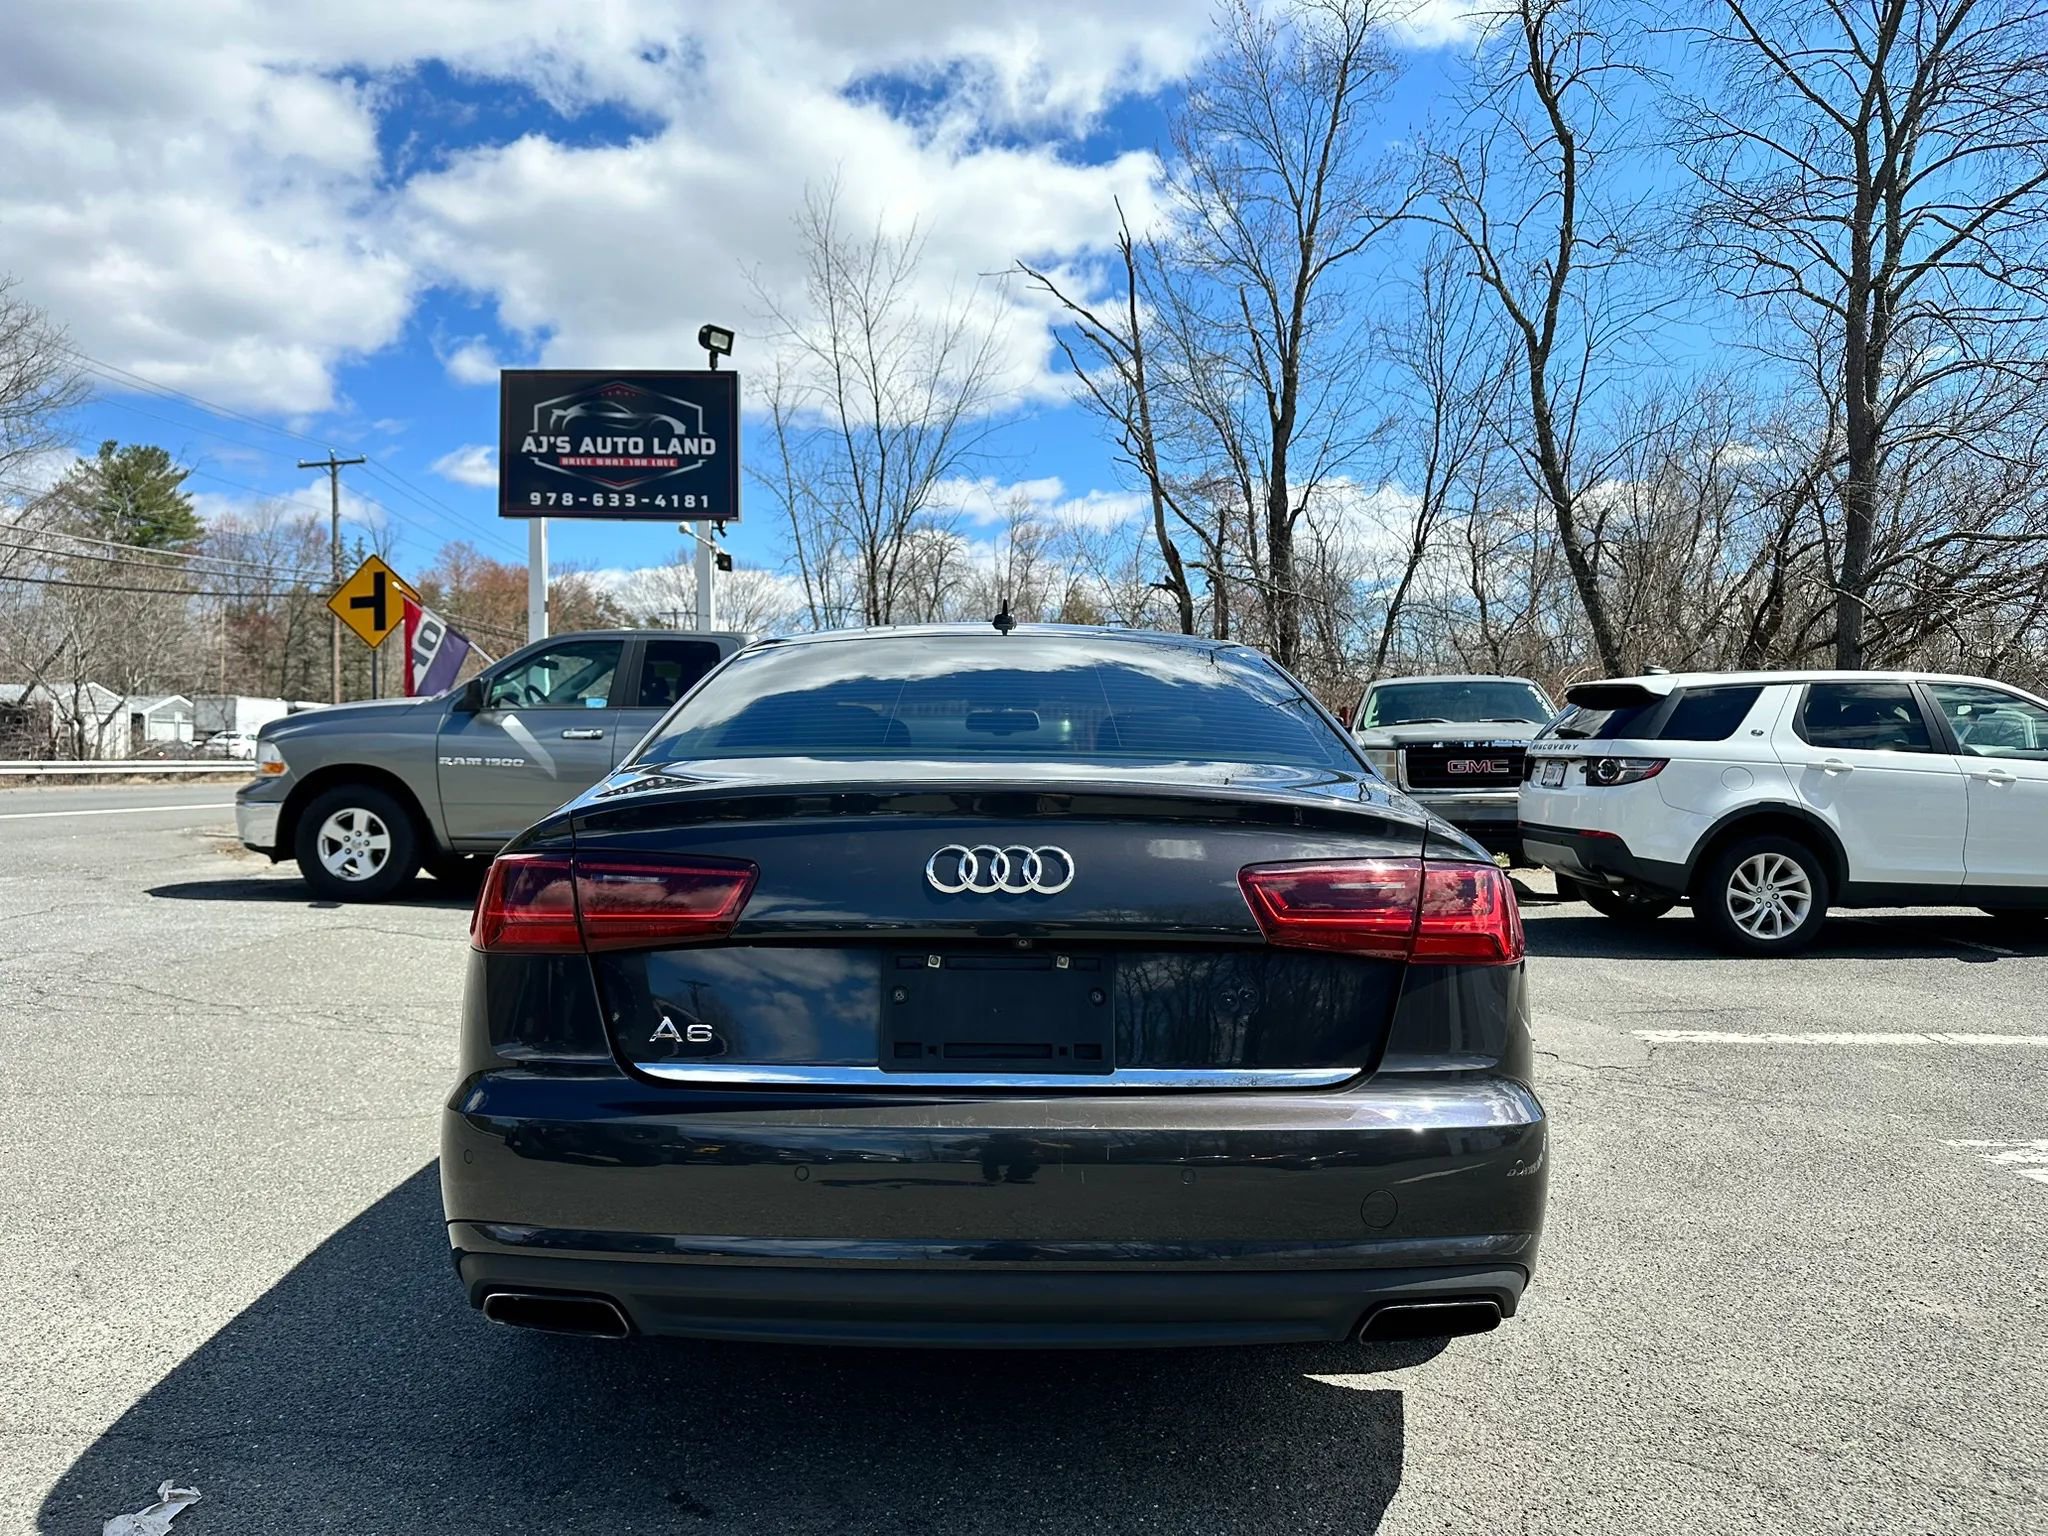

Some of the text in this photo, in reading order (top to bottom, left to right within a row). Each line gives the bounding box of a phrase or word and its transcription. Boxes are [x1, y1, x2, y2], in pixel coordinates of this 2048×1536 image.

[521, 436, 716, 455] AJ'S AUTO LAND
[561, 457, 676, 467] DRIVE WHAT YOU LOVE
[529, 492, 709, 508] 978-633-4181
[439, 756, 525, 767] RAM 1500
[1447, 759, 1509, 773] GMC
[648, 1016, 713, 1042] A6
